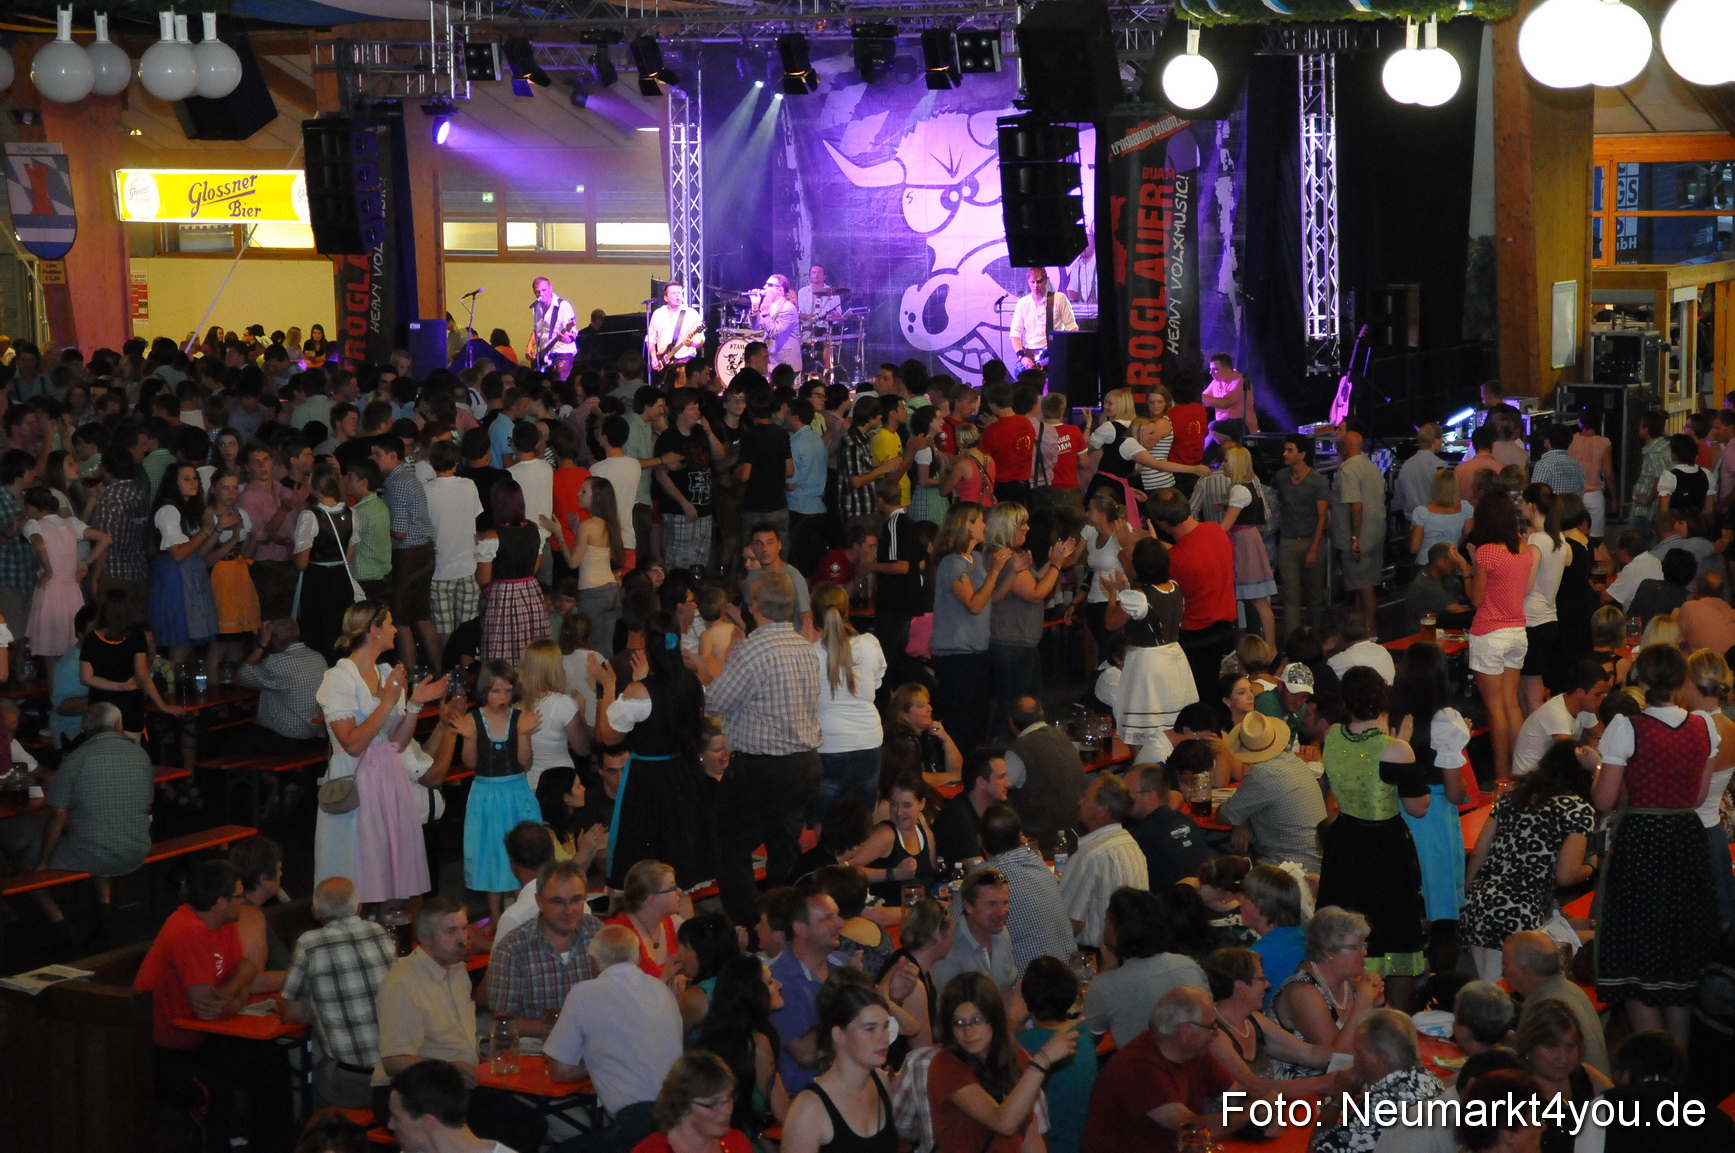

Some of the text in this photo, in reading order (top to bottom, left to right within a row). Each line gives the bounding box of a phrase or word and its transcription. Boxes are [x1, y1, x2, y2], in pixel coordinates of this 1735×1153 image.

[1142, 166, 1176, 181] BUAM
[188, 174, 258, 218] Glossner
[228, 200, 262, 218] Bier
[1166, 173, 1190, 355] HEAVY VOLXMUSIC!
[370, 283, 382, 333] HEAVY
